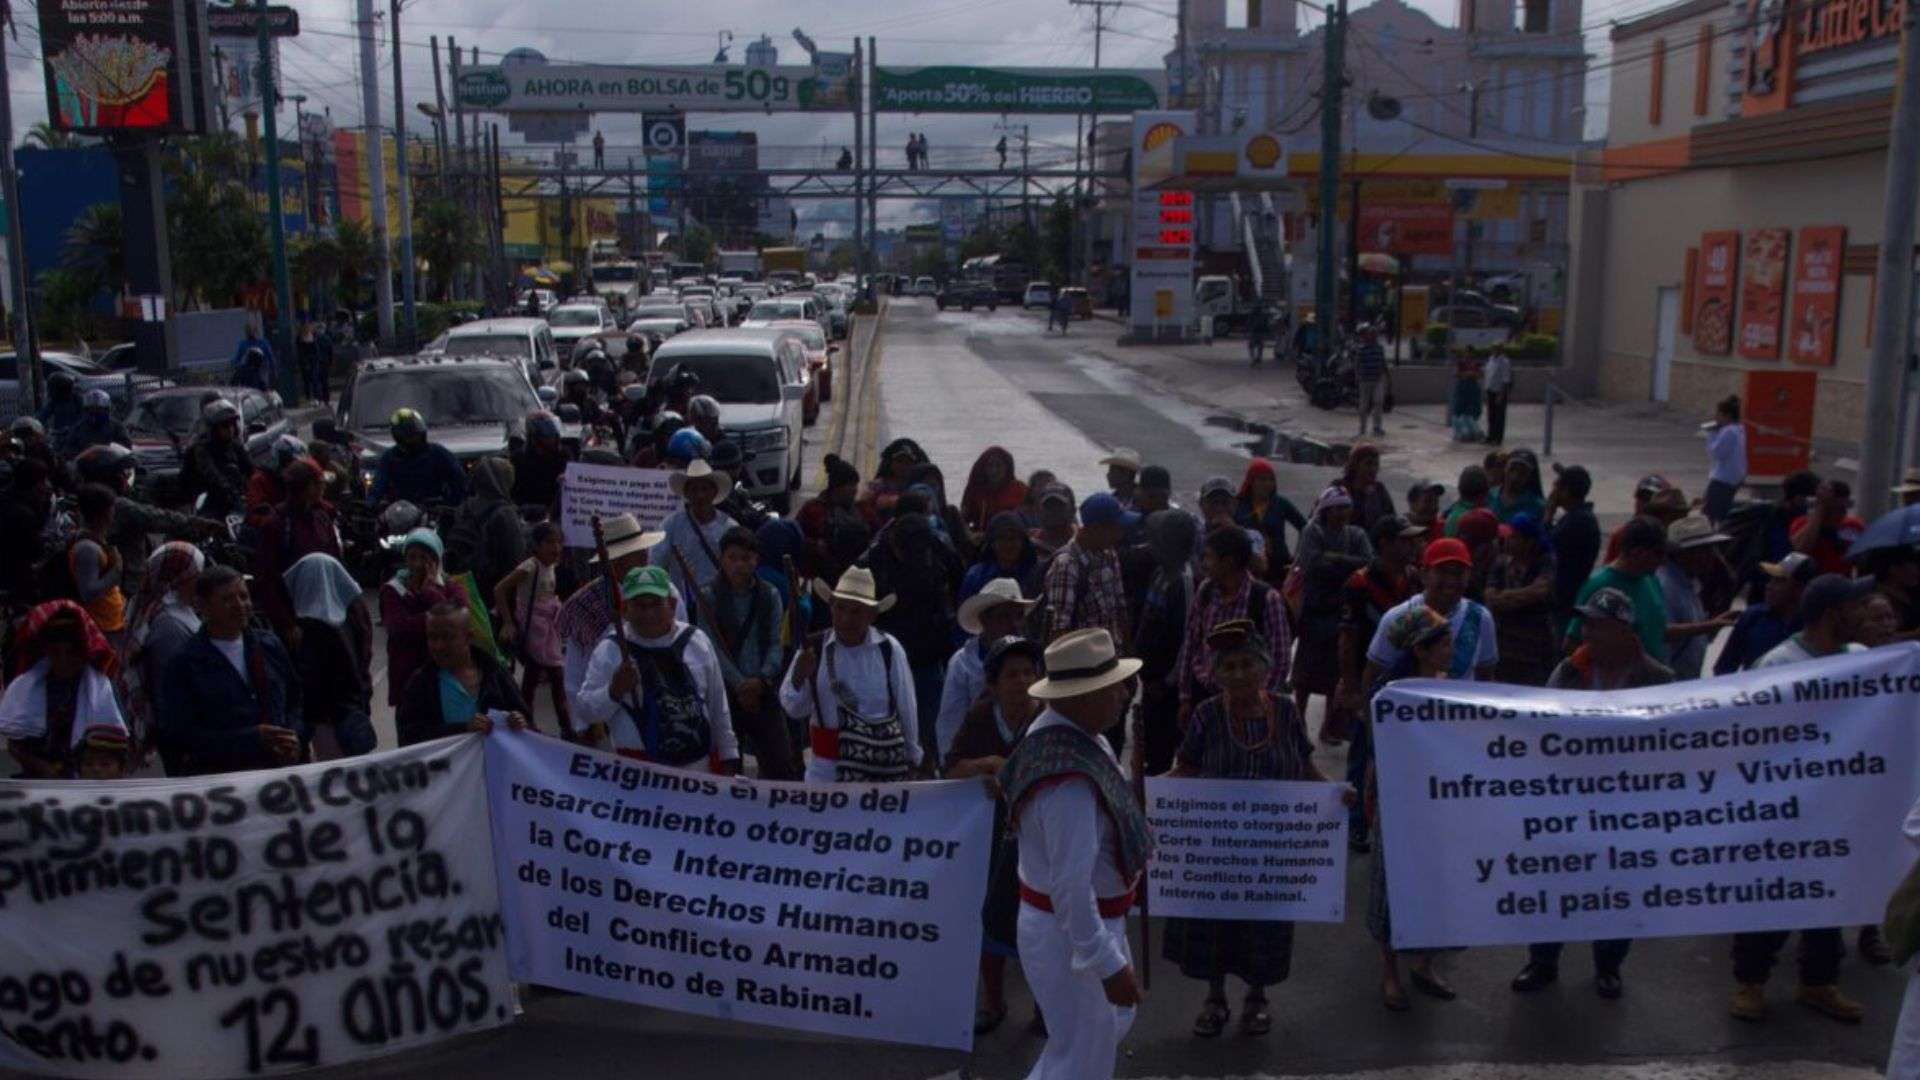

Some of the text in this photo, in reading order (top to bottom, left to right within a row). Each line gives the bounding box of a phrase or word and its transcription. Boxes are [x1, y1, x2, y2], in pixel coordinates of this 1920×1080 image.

[1797, 0, 1869, 55] Little
[524, 70, 789, 101] AHORA en BOLSA de 50g
[944, 83, 991, 104] 50%
[1020, 86, 1093, 104] HIERRO
[1375, 700, 1517, 723] Pedimos
[1487, 722, 1832, 759] de Comunicaciones,
[258, 773, 315, 816] el
[569, 753, 718, 797] Exigimos
[768, 788, 849, 814] pago
[860, 788, 910, 813] del
[1429, 751, 1886, 800] Infraestructura y Vivienda
[511, 780, 962, 863] resarcimiento otorgado por
[1156, 797, 1318, 815] Exigimos el pago del
[1243, 819, 1313, 834] otorgado
[1316, 820, 1341, 833] por
[1523, 796, 1800, 841] por incapacidad
[265, 818, 346, 869] de
[528, 821, 931, 901] la Corte Interamericana
[1157, 851, 1335, 868] los Derechos Humanos
[1159, 834, 1330, 850] Corte Interamericana
[1476, 833, 1850, 882] y tener las carreteras
[1150, 868, 1318, 885] del Conflicto Armado
[1159, 886, 1308, 903] Interno de Rabinal.
[1496, 890, 1549, 917] del
[1643, 875, 1837, 908] destruidas.
[517, 860, 941, 943] de los Derechos Humanos
[105, 951, 171, 999] de
[187, 931, 370, 991] nuestro
[547, 906, 900, 980] del Conflicto Armado
[565, 947, 874, 1020] Interno de Rabinal.
